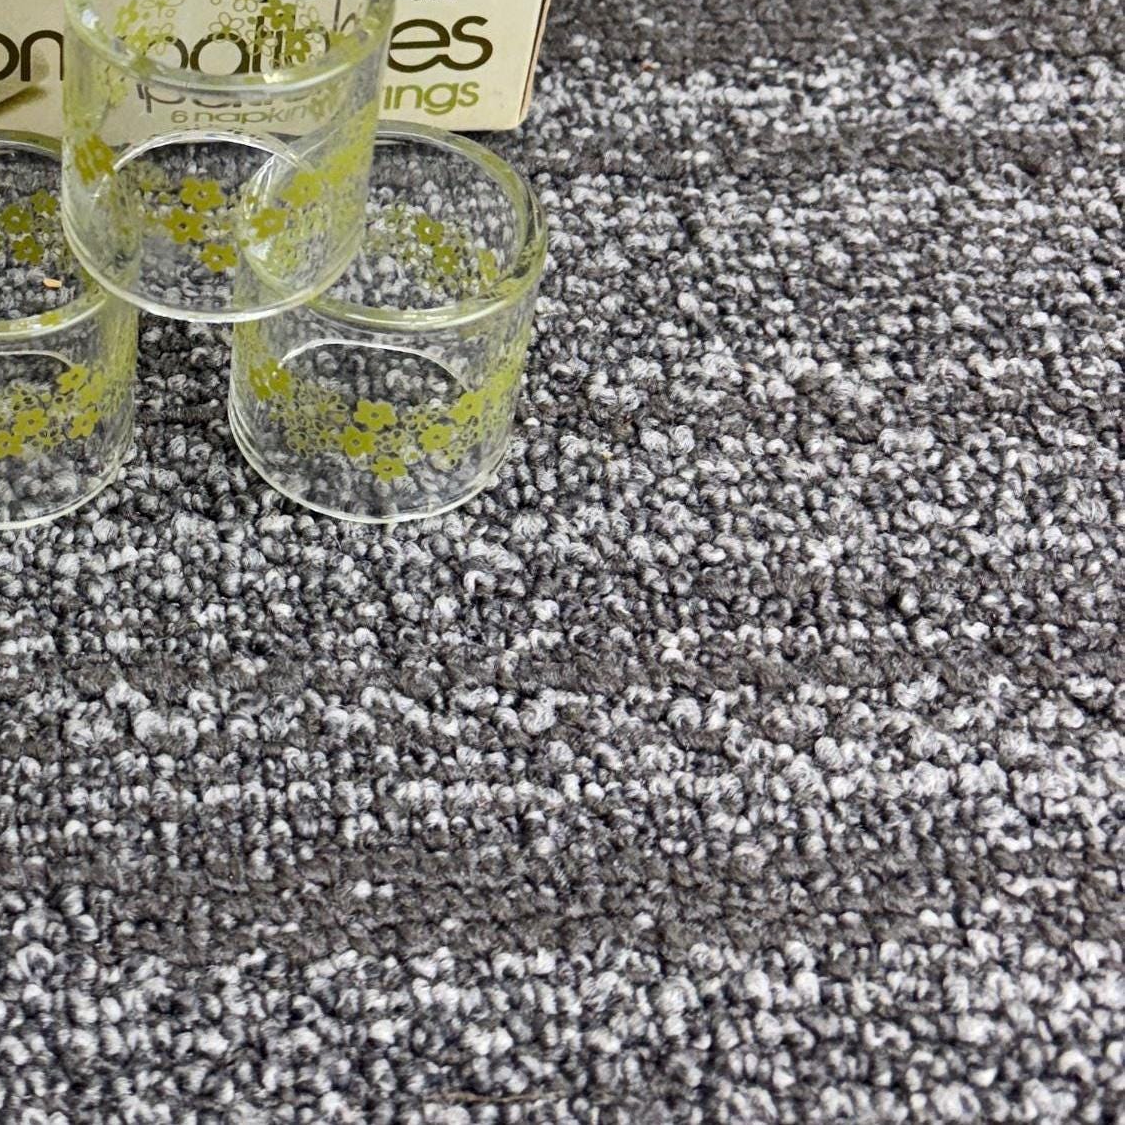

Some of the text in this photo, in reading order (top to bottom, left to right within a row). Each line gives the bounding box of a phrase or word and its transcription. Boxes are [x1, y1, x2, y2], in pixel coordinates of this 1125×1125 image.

[170, 81, 481, 124] 6 napkin ings
